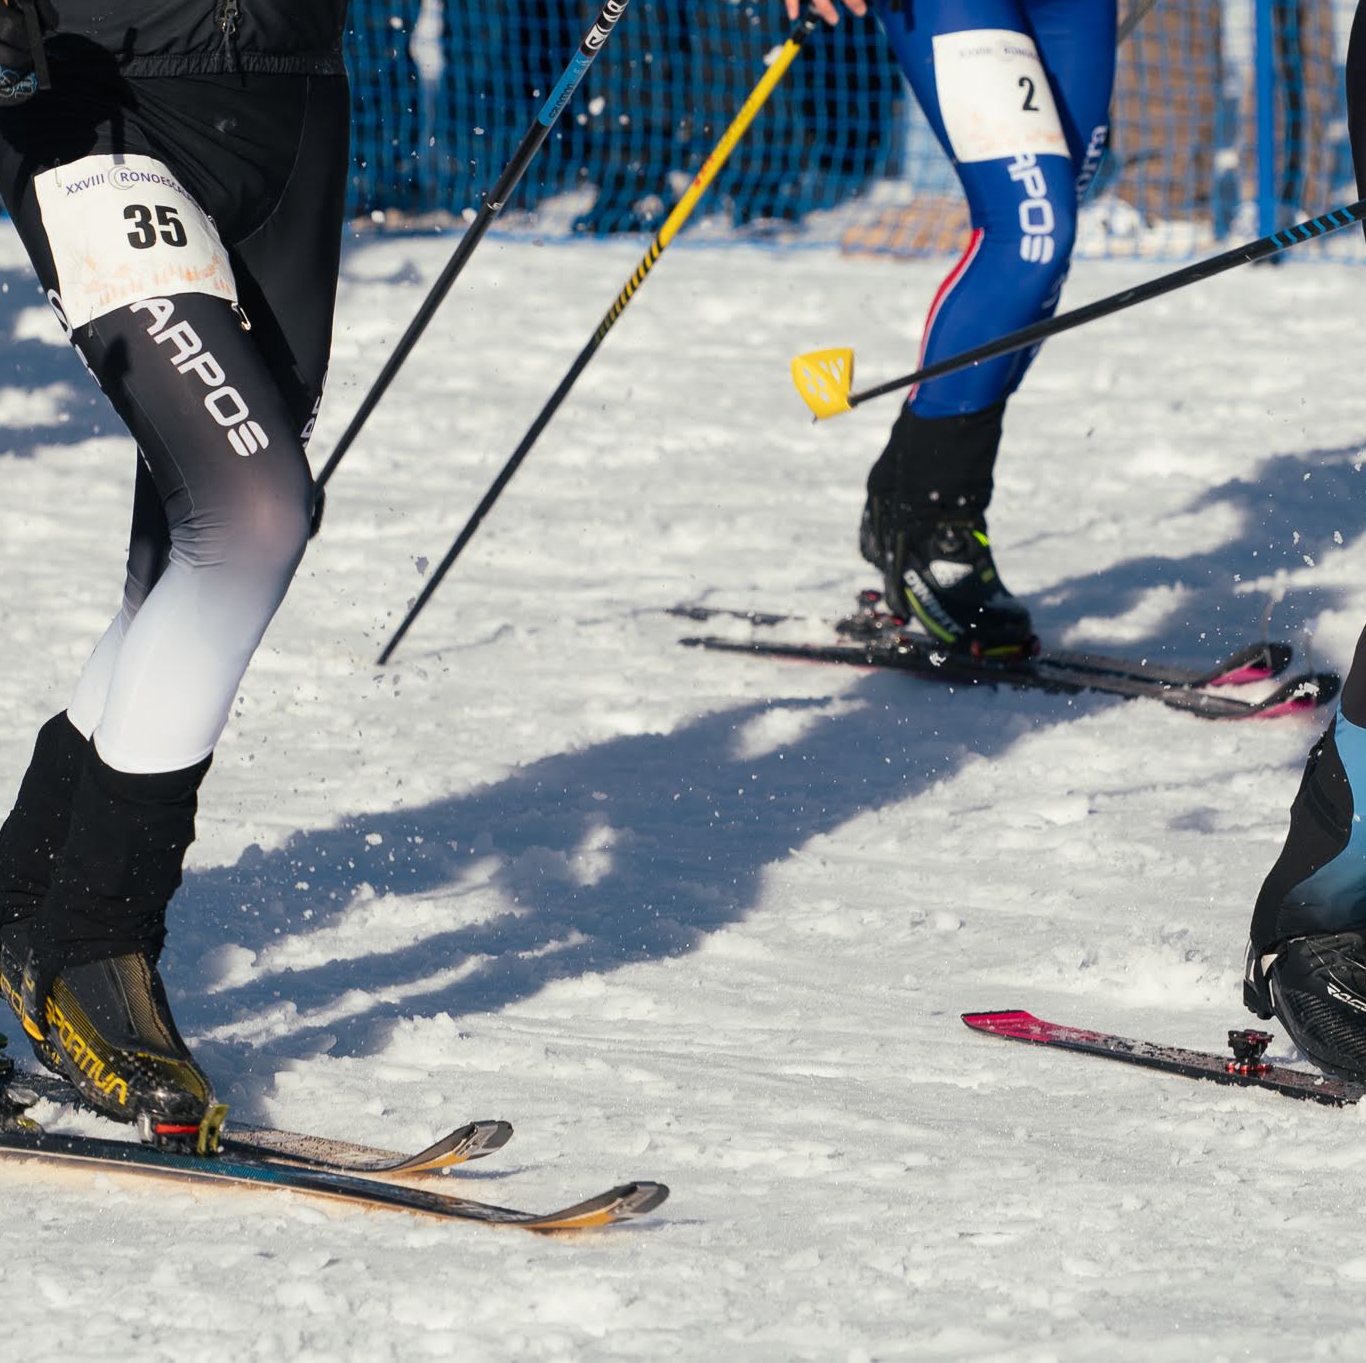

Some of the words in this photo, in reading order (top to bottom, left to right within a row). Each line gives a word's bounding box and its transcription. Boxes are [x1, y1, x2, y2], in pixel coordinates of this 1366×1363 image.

[1018, 76, 1040, 111] 2
[66, 173, 105, 196] XXVIII
[124, 204, 188, 249] 35
[130, 298, 269, 456] ARPOS
